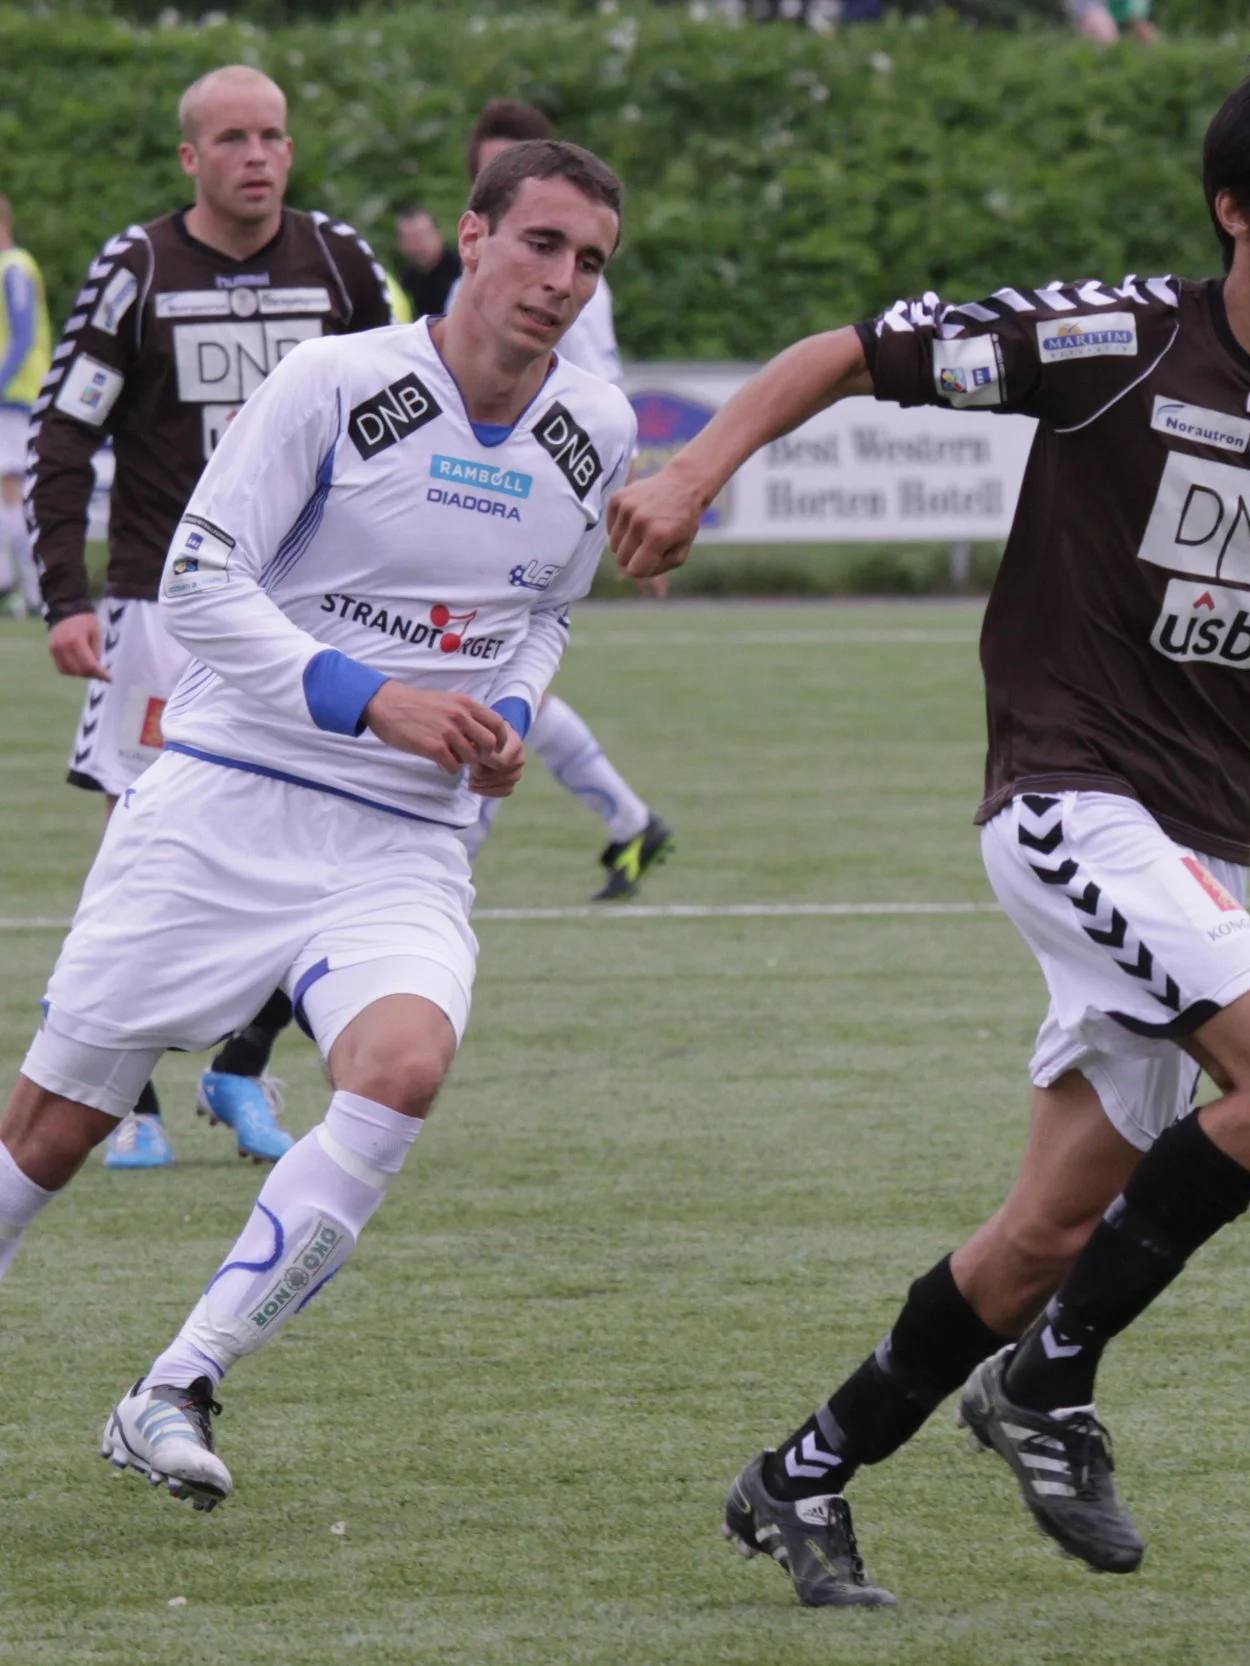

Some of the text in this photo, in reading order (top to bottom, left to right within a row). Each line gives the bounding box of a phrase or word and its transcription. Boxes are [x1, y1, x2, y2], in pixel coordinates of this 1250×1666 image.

[1049, 332, 1129, 350] MARITIM
[355, 386, 429, 446] DNB
[1165, 416, 1246, 448] Norautron
[543, 415, 596, 487] DNB
[848, 424, 992, 465] Western
[426, 488, 522, 522] DIADORA
[765, 479, 886, 520] Horten
[250, 1287, 292, 1327] NOR
